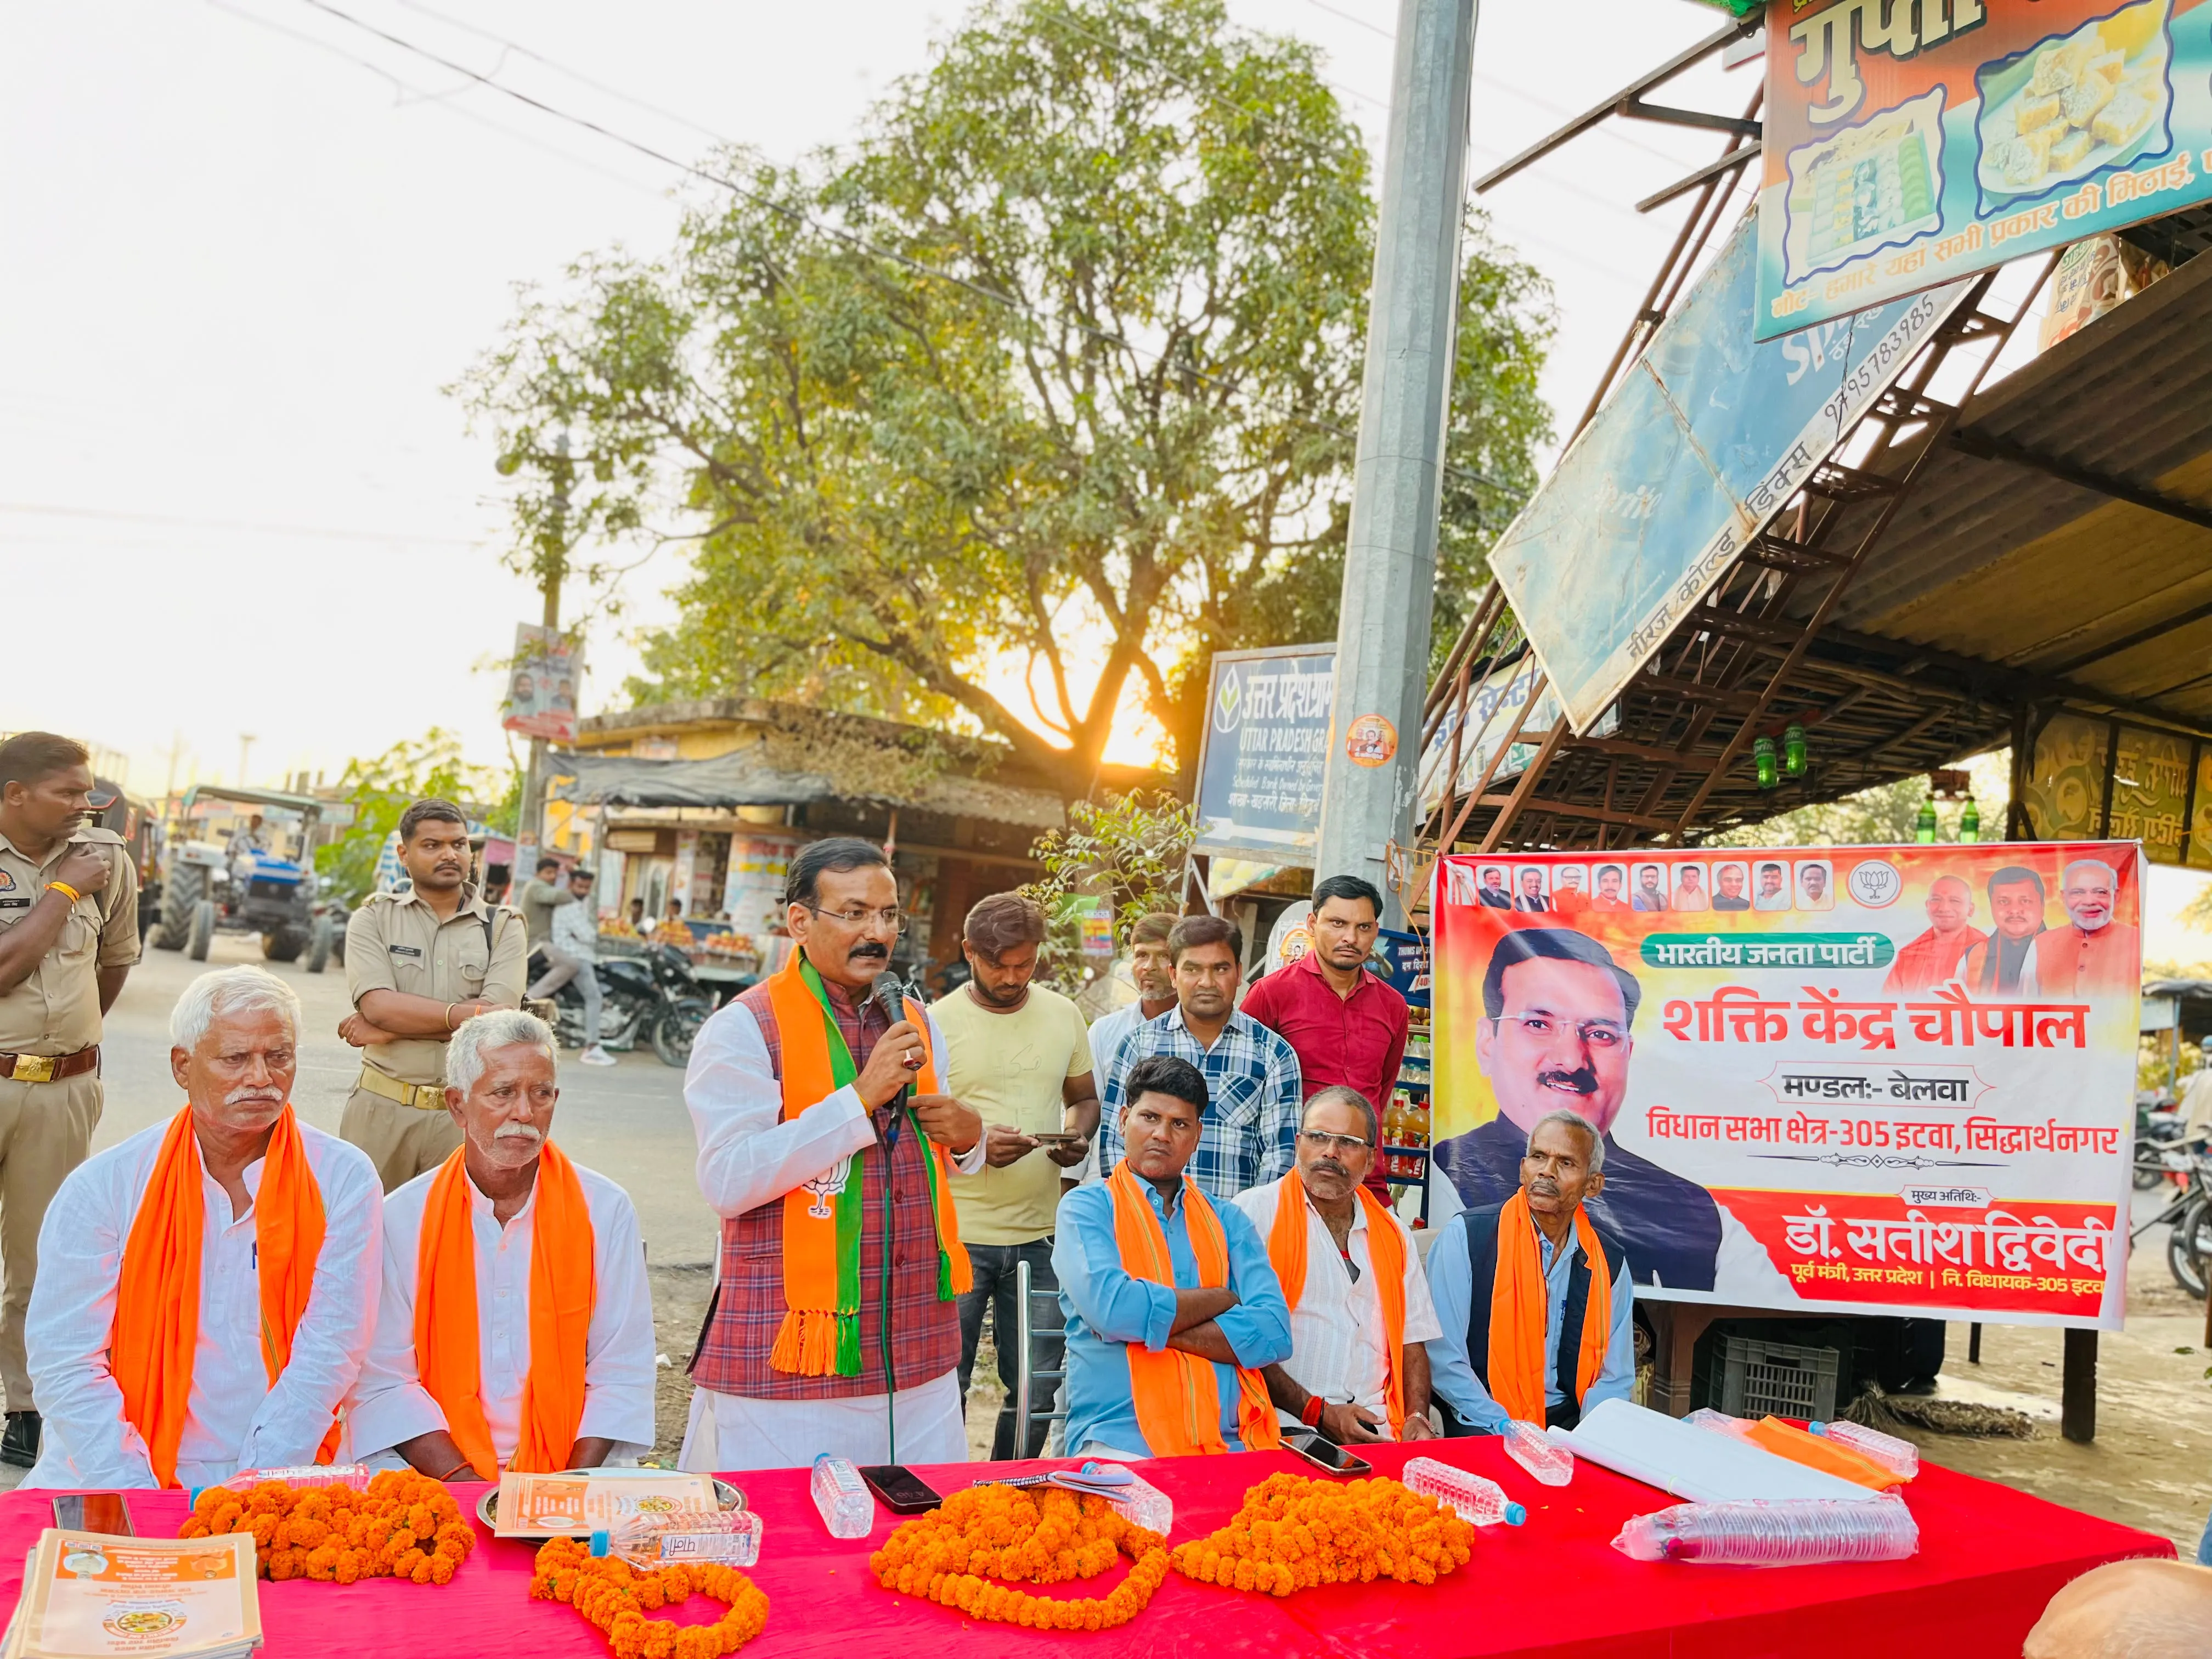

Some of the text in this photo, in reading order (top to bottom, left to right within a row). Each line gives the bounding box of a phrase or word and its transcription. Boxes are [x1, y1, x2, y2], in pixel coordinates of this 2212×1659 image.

[1826, 260, 1877, 301] हमारे
[1884, 241, 1927, 276] यहां
[1933, 224, 1985, 263] सभी
[1990, 200, 2061, 247] प्रकार
[2062, 182, 2103, 220] की
[2106, 150, 2196, 208] मिठाई,
[1627, 602, 1677, 659] नीरज
[1242, 674, 1278, 720] उत्तर
[1240, 727, 1268, 752] UTTAR
[1269, 727, 1312, 754] PRADESH
[1233, 775, 1260, 789] Scheduled
[1261, 776, 1278, 790] Bank
[1279, 777, 1298, 791] Owned
[1398, 946, 1415, 956] THUMS
[1656, 936, 1877, 965] भारतीय जनता पार्टी
[1663, 983, 2091, 1050] शक्ति केंद्र चौपाल
[1887, 1069, 1970, 1102] बेलवा
[1645, 1105, 2119, 1154] विधान सभा क्षेत्र-305 इटवा, सिद्धार्थनगर
[1911, 1189, 1937, 1204] मुख्य
[1782, 1204, 1843, 1261] डॉ.
[1844, 1209, 1978, 1267] सतीश
[1791, 1260, 1816, 1283] पूर्व
[1816, 1261, 1850, 1283] मंत्री,
[1852, 1267, 1883, 1283] उत्तर
[1884, 1265, 1923, 1285] प्रदेश
[1942, 1268, 1963, 1287] नि.
[1965, 1269, 2068, 1292] विधायक-305
[669, 1536, 696, 1556] पानी
